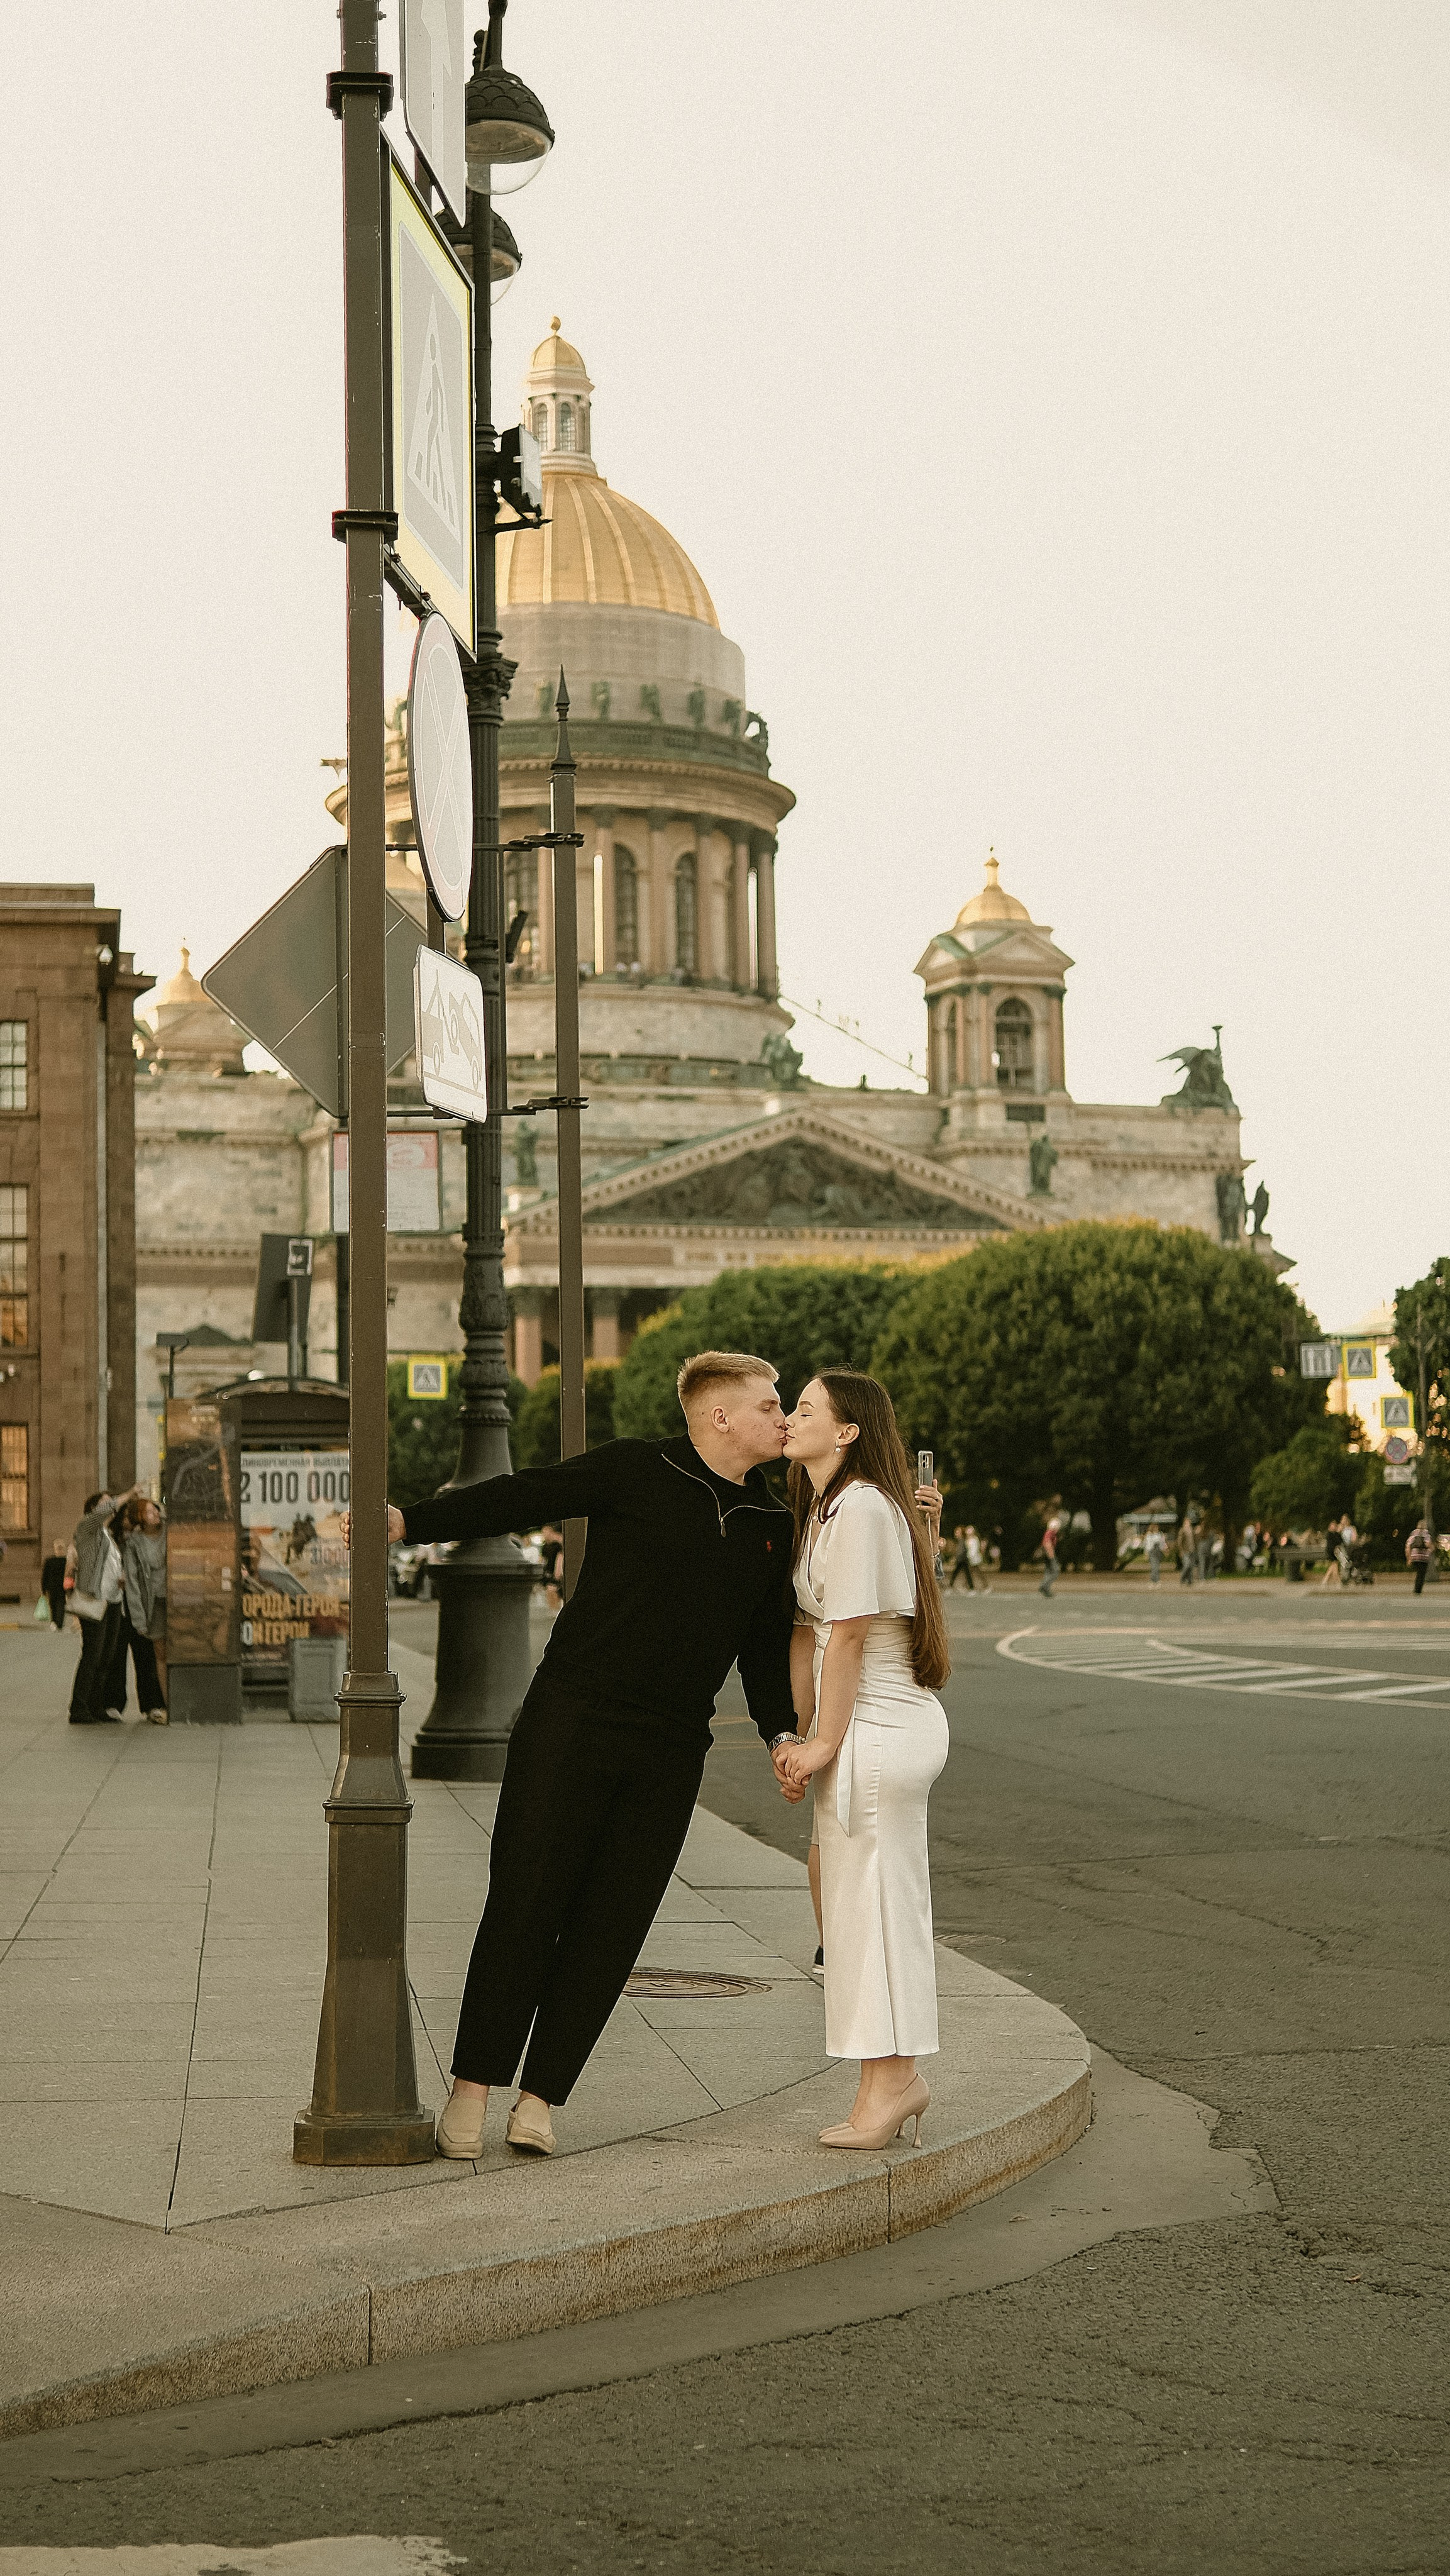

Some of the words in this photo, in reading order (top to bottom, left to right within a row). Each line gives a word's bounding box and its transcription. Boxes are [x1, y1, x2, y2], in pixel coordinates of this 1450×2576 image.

[241, 1470, 251, 1504] 2
[258, 1470, 299, 1504] 100
[307, 1470, 349, 1504] 000
